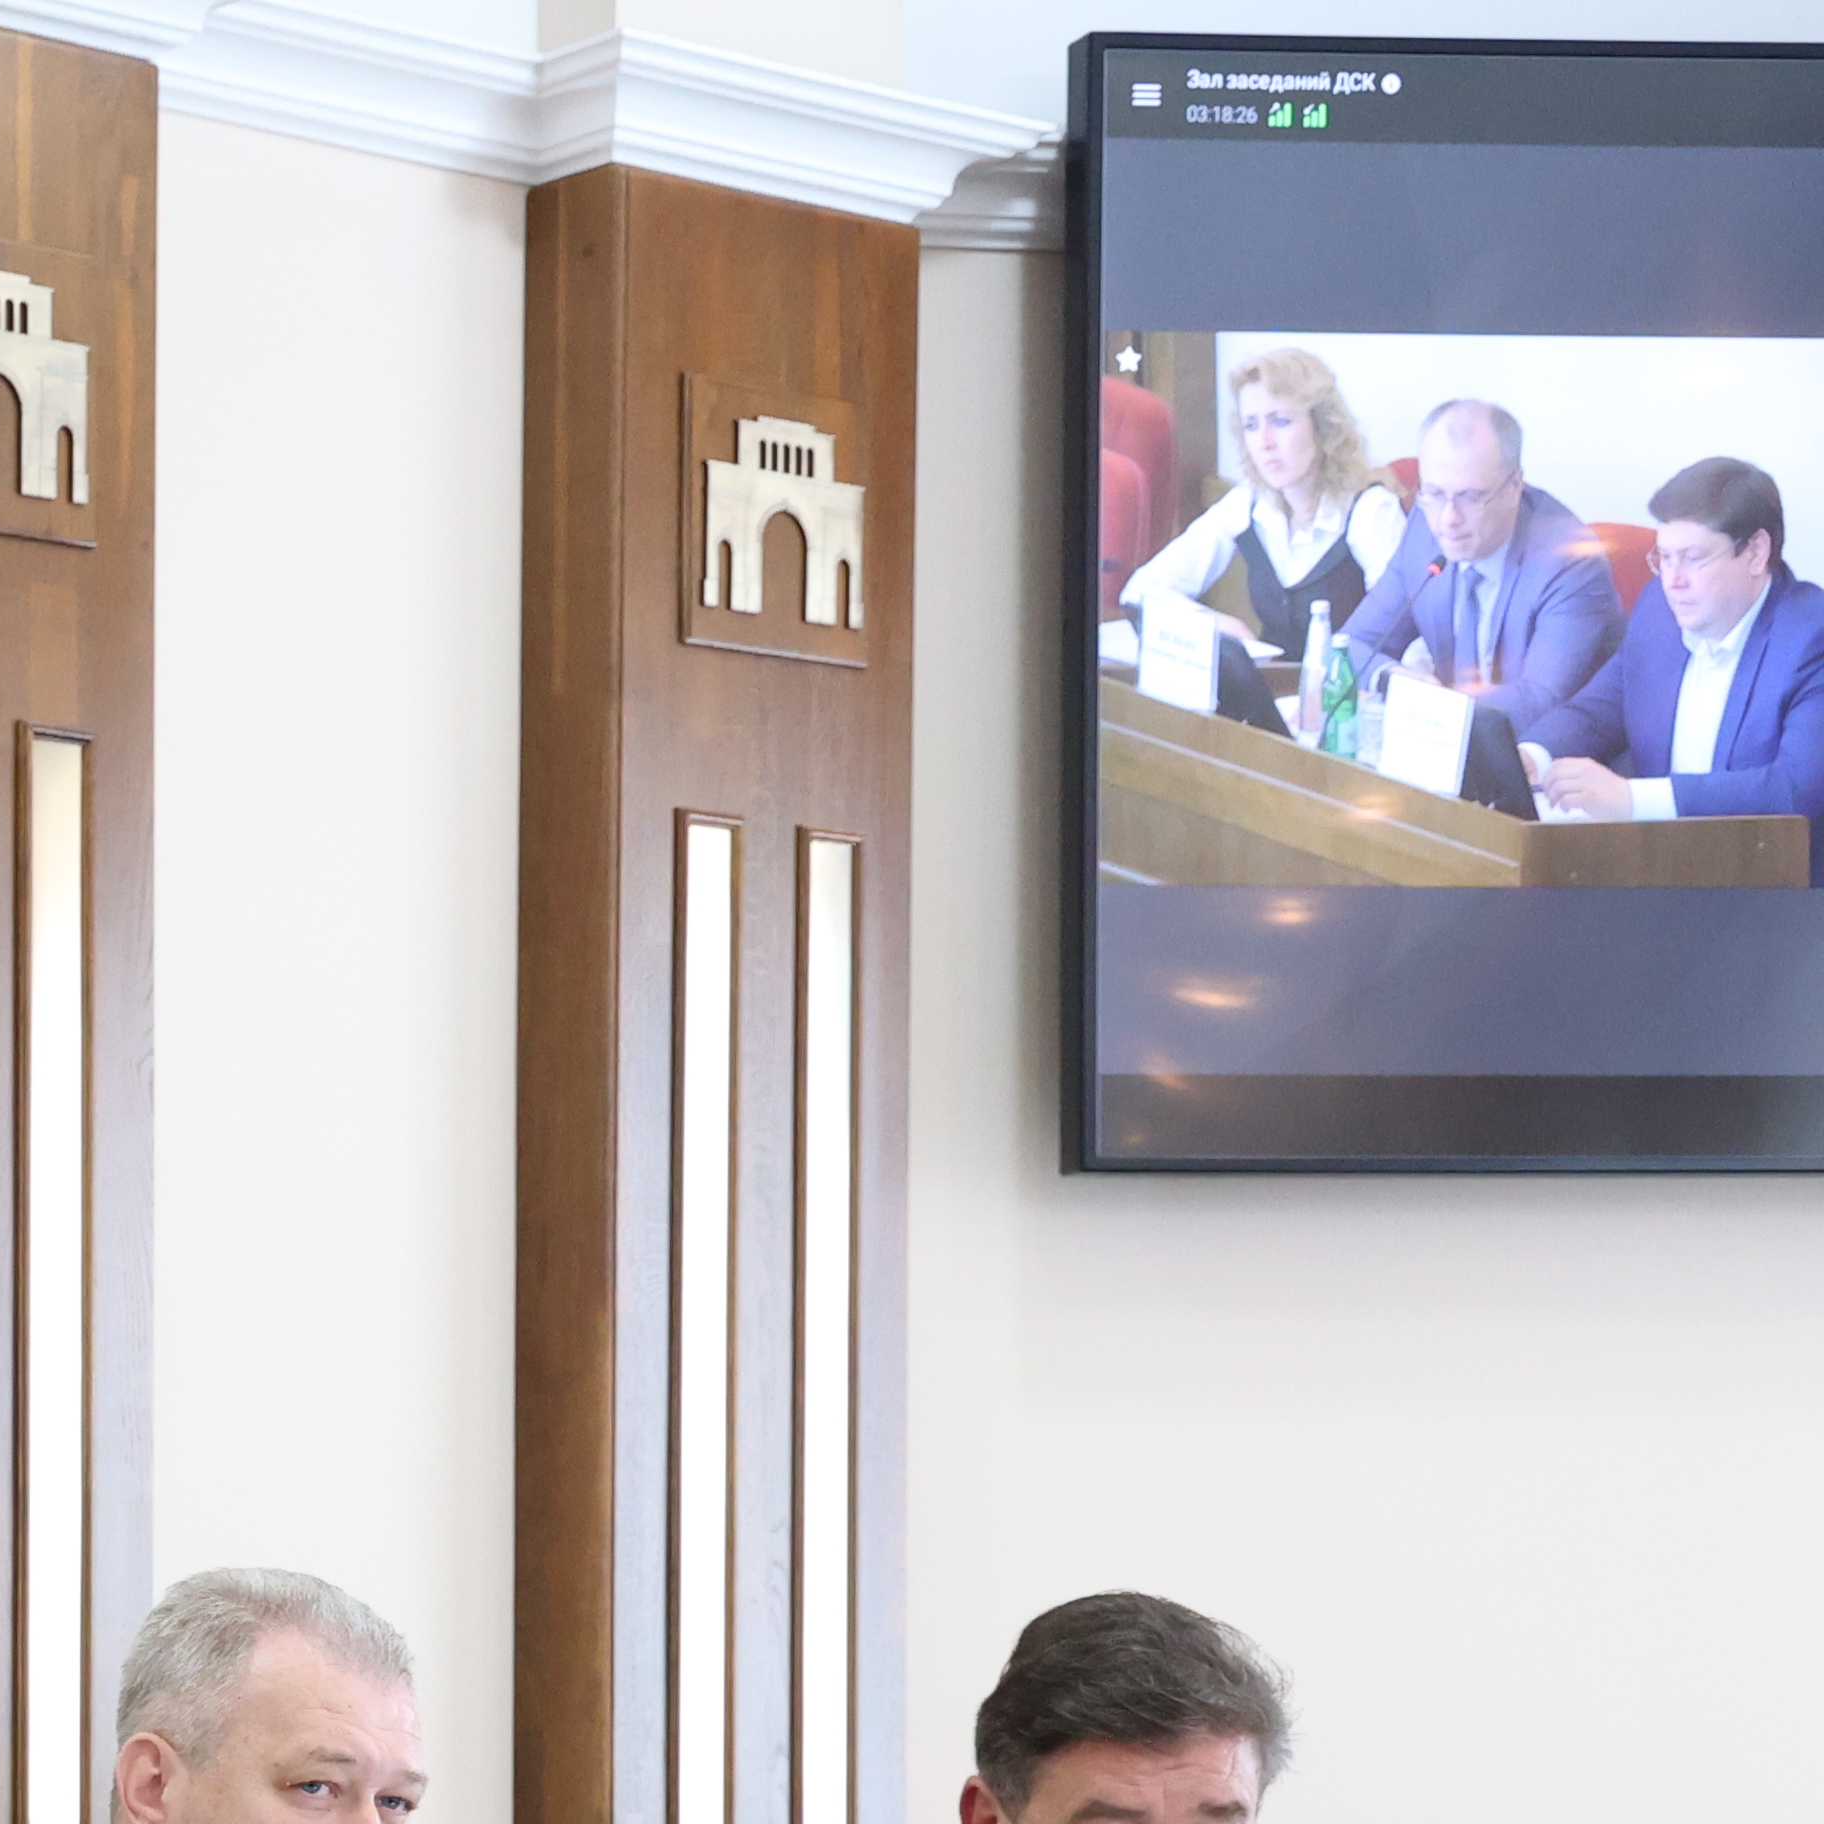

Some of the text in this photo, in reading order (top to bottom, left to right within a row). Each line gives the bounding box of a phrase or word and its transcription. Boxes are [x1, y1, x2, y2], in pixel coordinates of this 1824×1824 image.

[1186, 68, 1376, 95] Зал заседаний ДСК
[1186, 104, 1259, 124] 03:18:26
